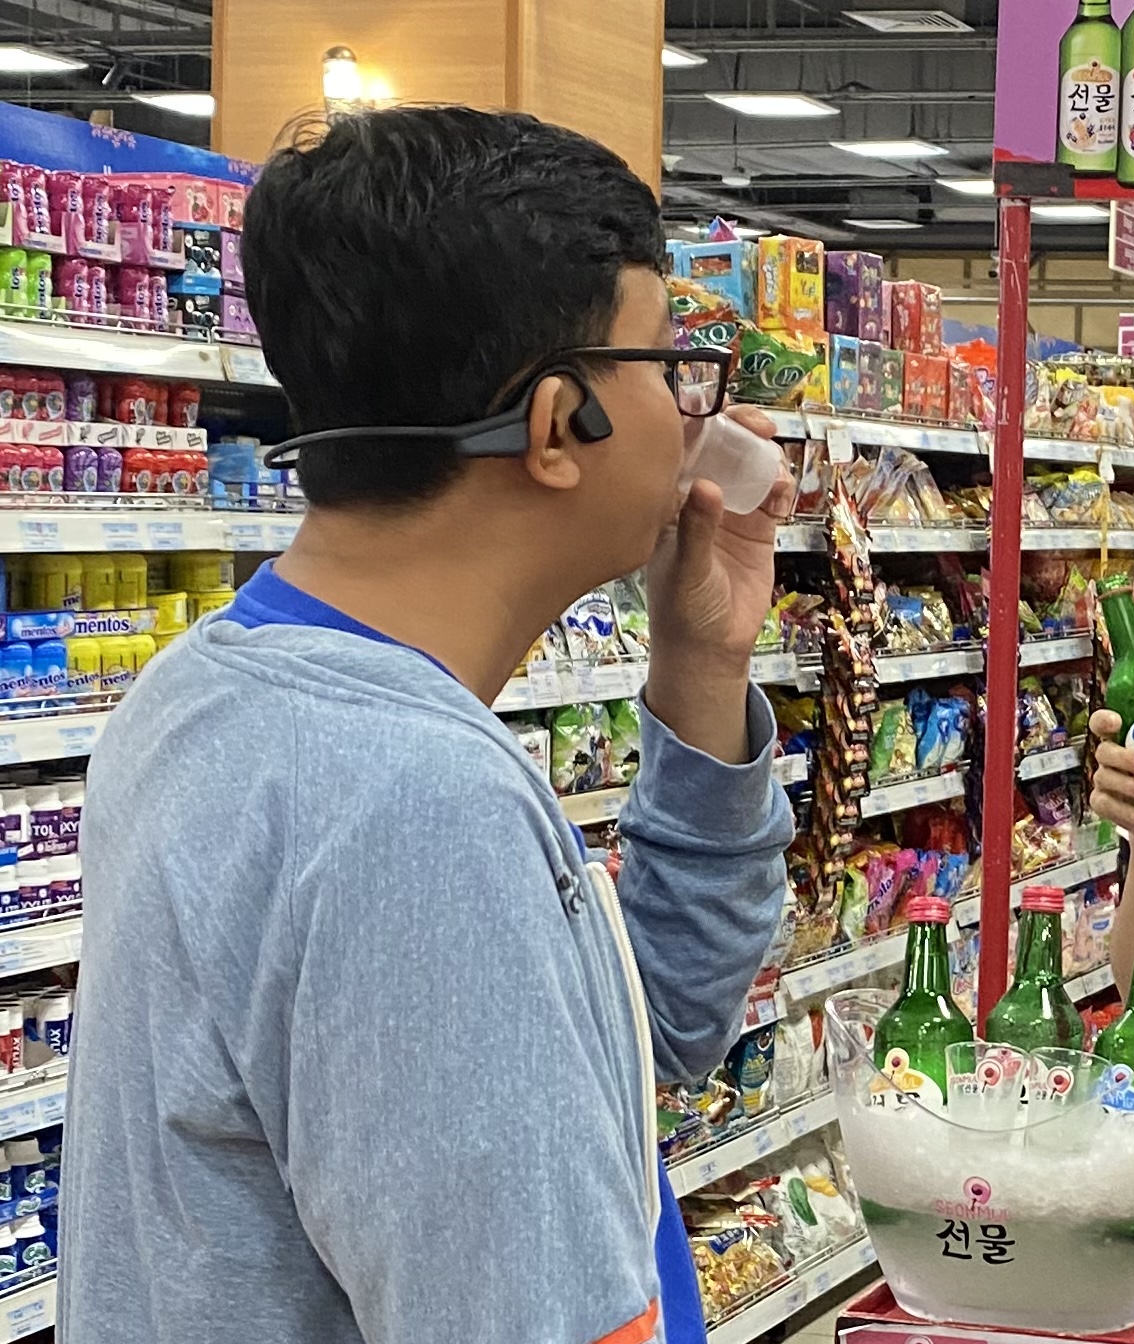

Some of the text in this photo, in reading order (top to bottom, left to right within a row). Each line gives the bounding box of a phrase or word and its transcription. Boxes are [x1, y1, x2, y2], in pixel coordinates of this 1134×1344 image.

[1068, 83, 1116, 113] 선물
[75, 617, 130, 634] mentos
[30, 671, 66, 688] entos
[935, 1219, 1016, 1265] 선물
